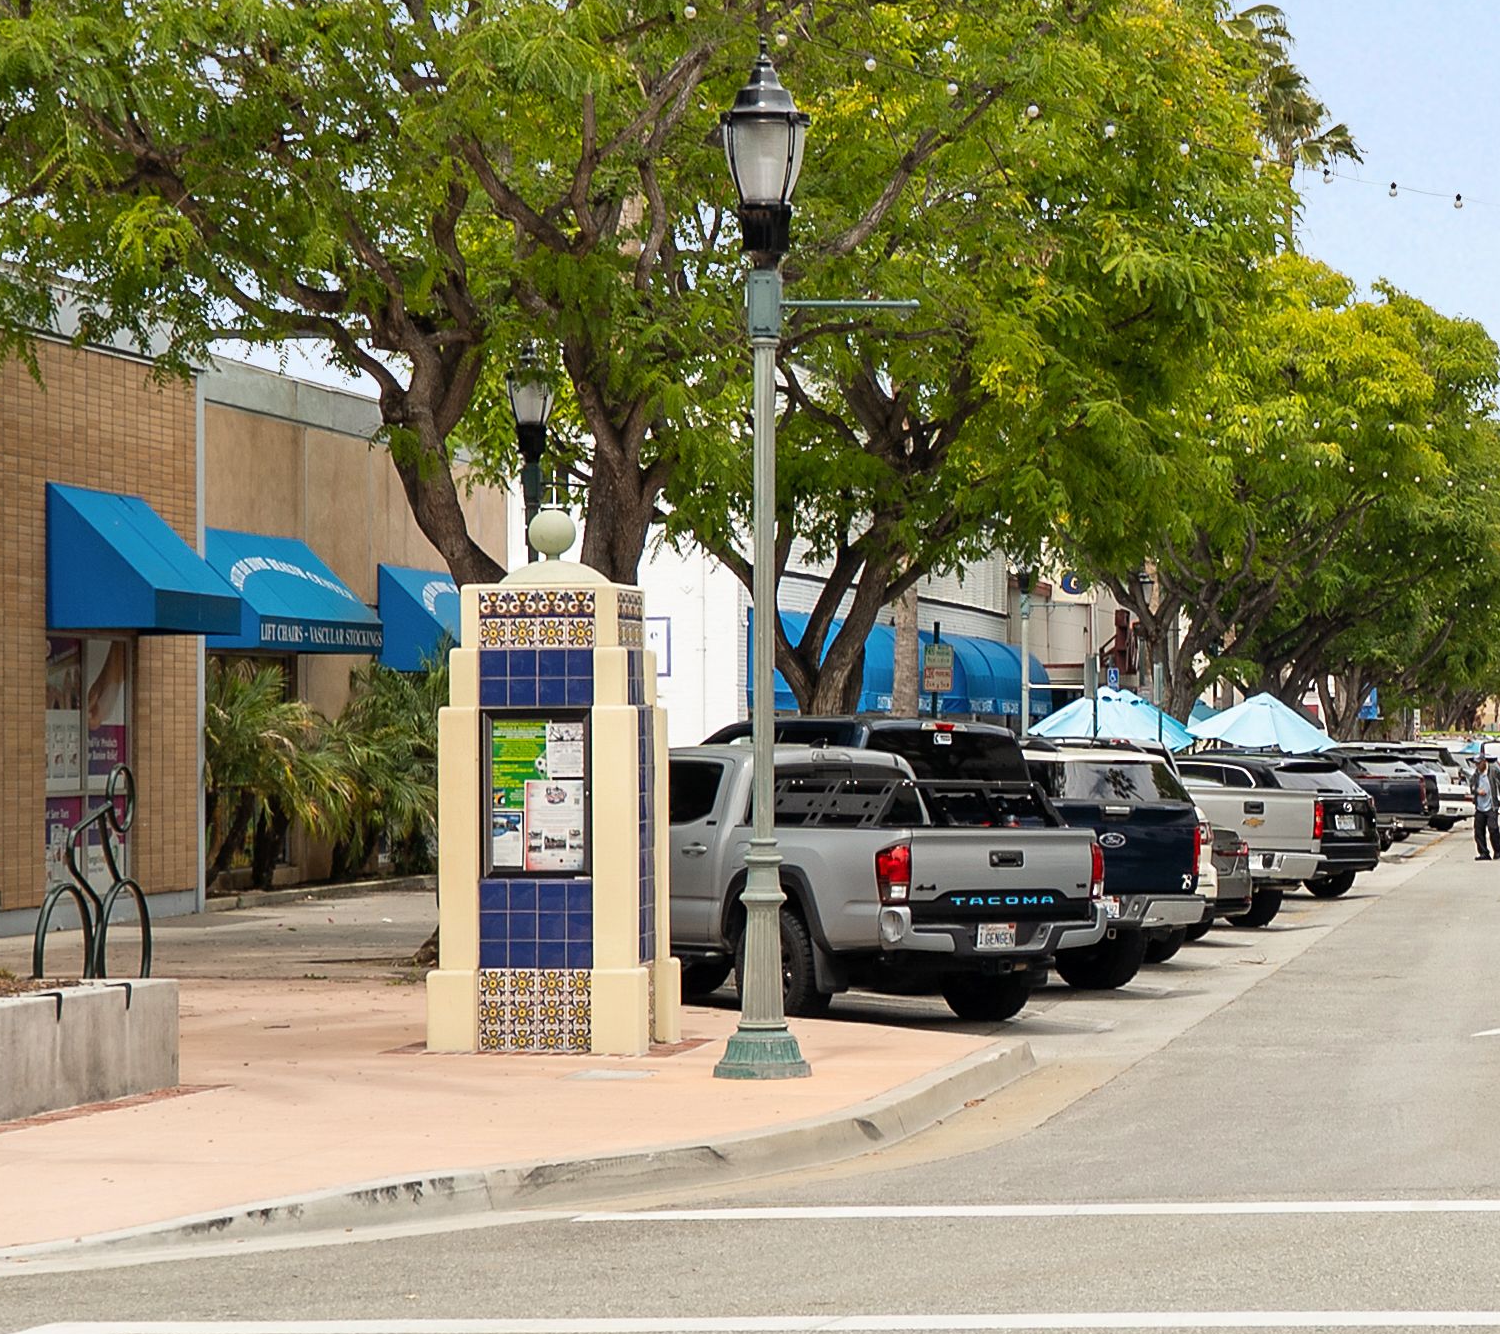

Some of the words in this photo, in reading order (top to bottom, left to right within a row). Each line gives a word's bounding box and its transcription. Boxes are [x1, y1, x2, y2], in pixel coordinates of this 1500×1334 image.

[260, 623, 276, 641] LIFT
[277, 624, 303, 643] CHAIRS
[309, 626, 345, 647] VASCULAR
[345, 628, 383, 647] STOCKINGS
[951, 895, 1054, 906] TACOMA
